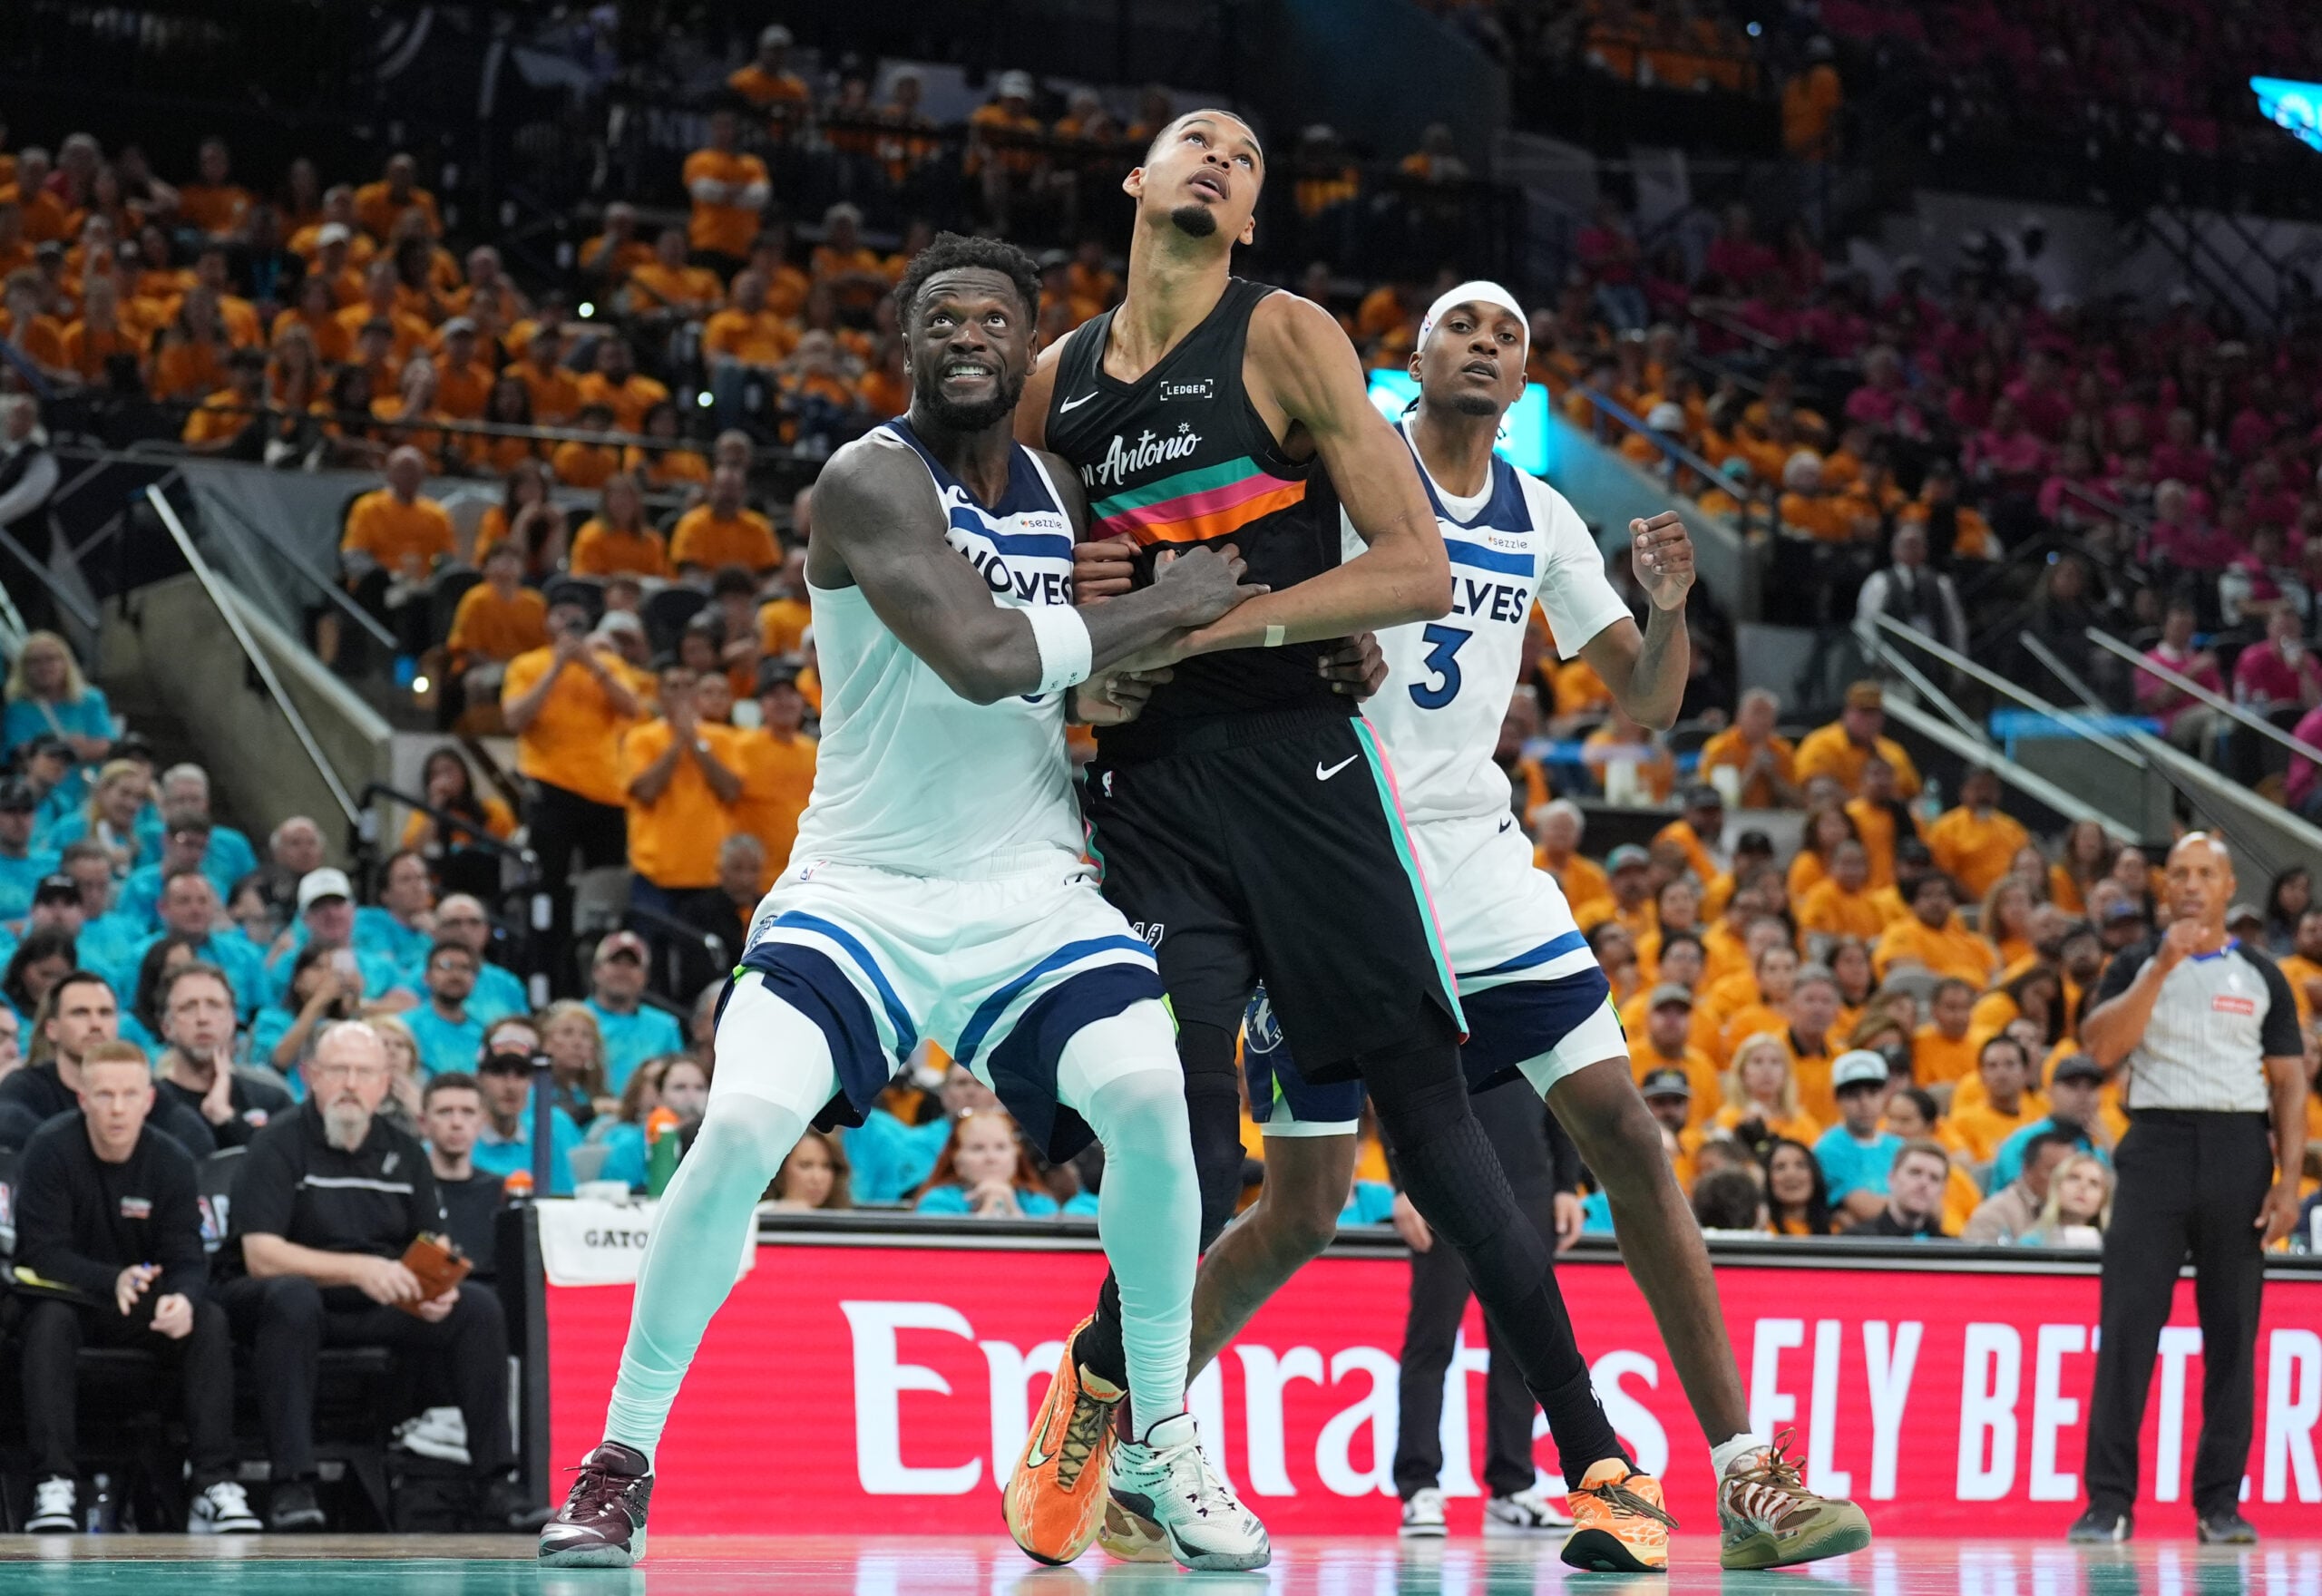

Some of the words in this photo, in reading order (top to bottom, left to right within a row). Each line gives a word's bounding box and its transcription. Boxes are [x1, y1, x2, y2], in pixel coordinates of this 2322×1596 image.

[1166, 384, 1206, 395] LEDGER
[1096, 426, 1202, 486] Antonio
[1029, 519, 1062, 529] sezzle
[1493, 538, 1527, 549] sezzle
[946, 540, 1071, 605] OVES
[1408, 622, 1473, 710] 3
[839, 1300, 1669, 1498] Erats
[1749, 1319, 1923, 1500] FLY
[1956, 1322, 2322, 1504] BETR
